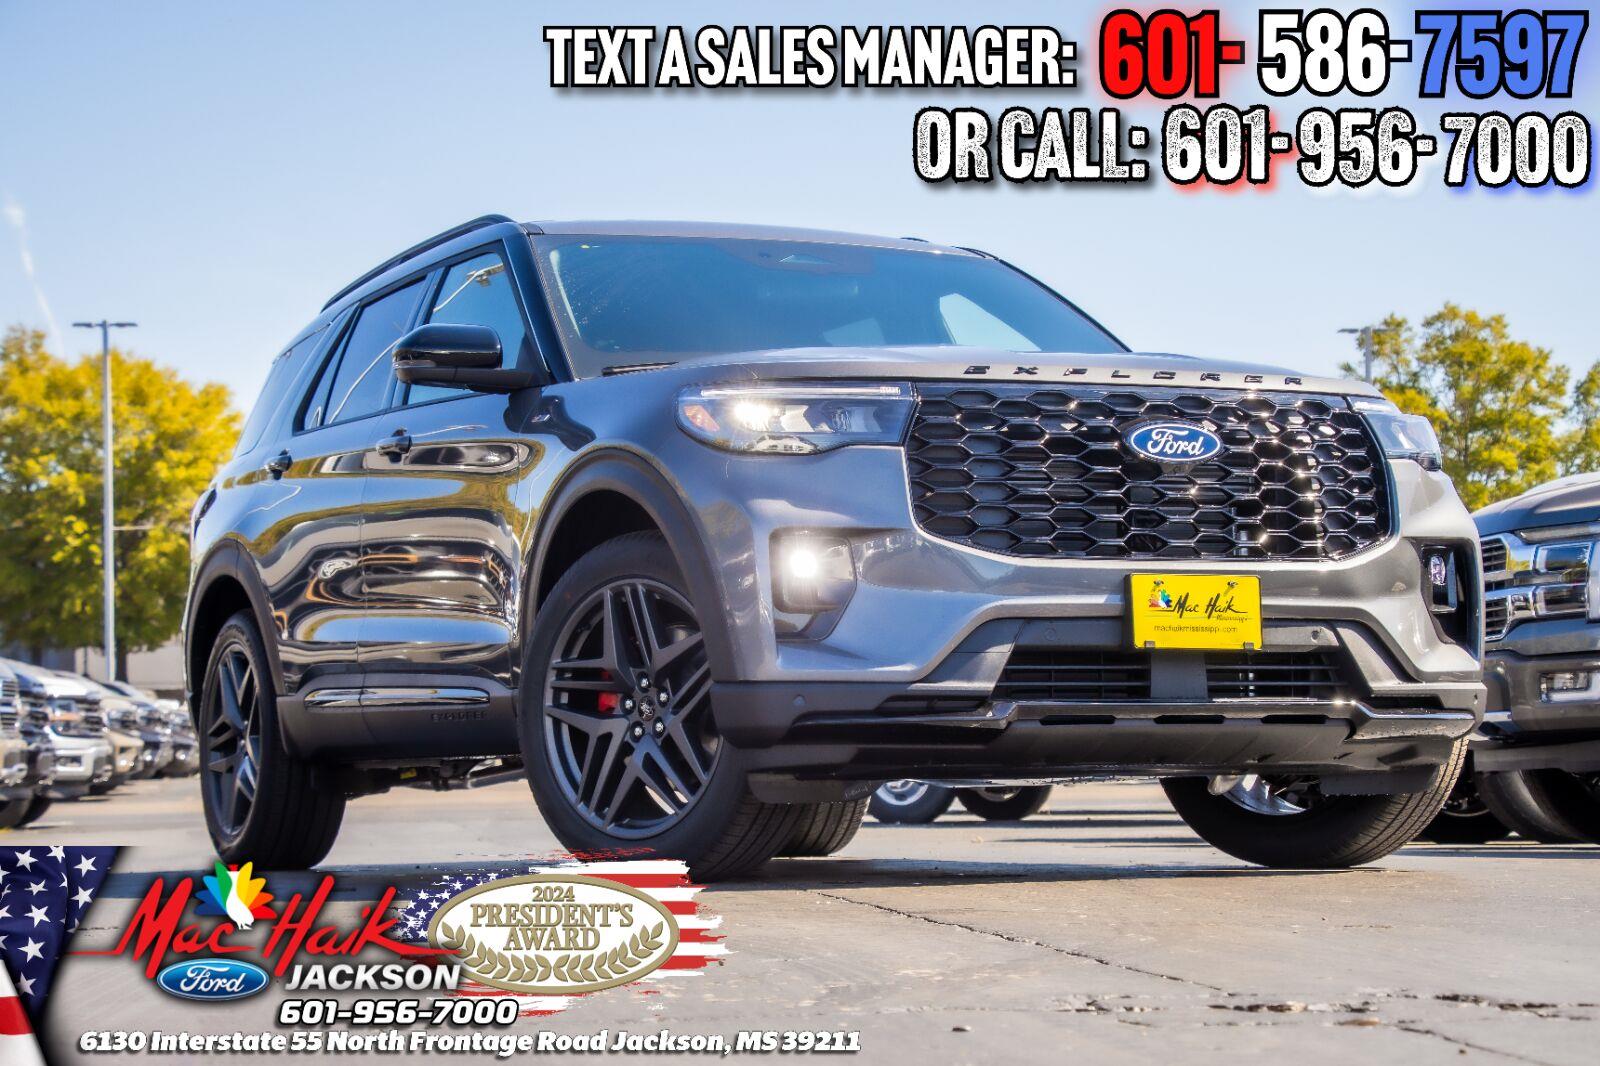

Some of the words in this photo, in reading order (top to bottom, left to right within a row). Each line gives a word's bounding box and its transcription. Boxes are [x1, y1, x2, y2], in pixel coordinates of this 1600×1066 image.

[963, 364, 1303, 386] EXPLORER
[1146, 427, 1205, 457] Ford
[1170, 592, 1200, 619] Mac
[1204, 592, 1248, 619] Haik
